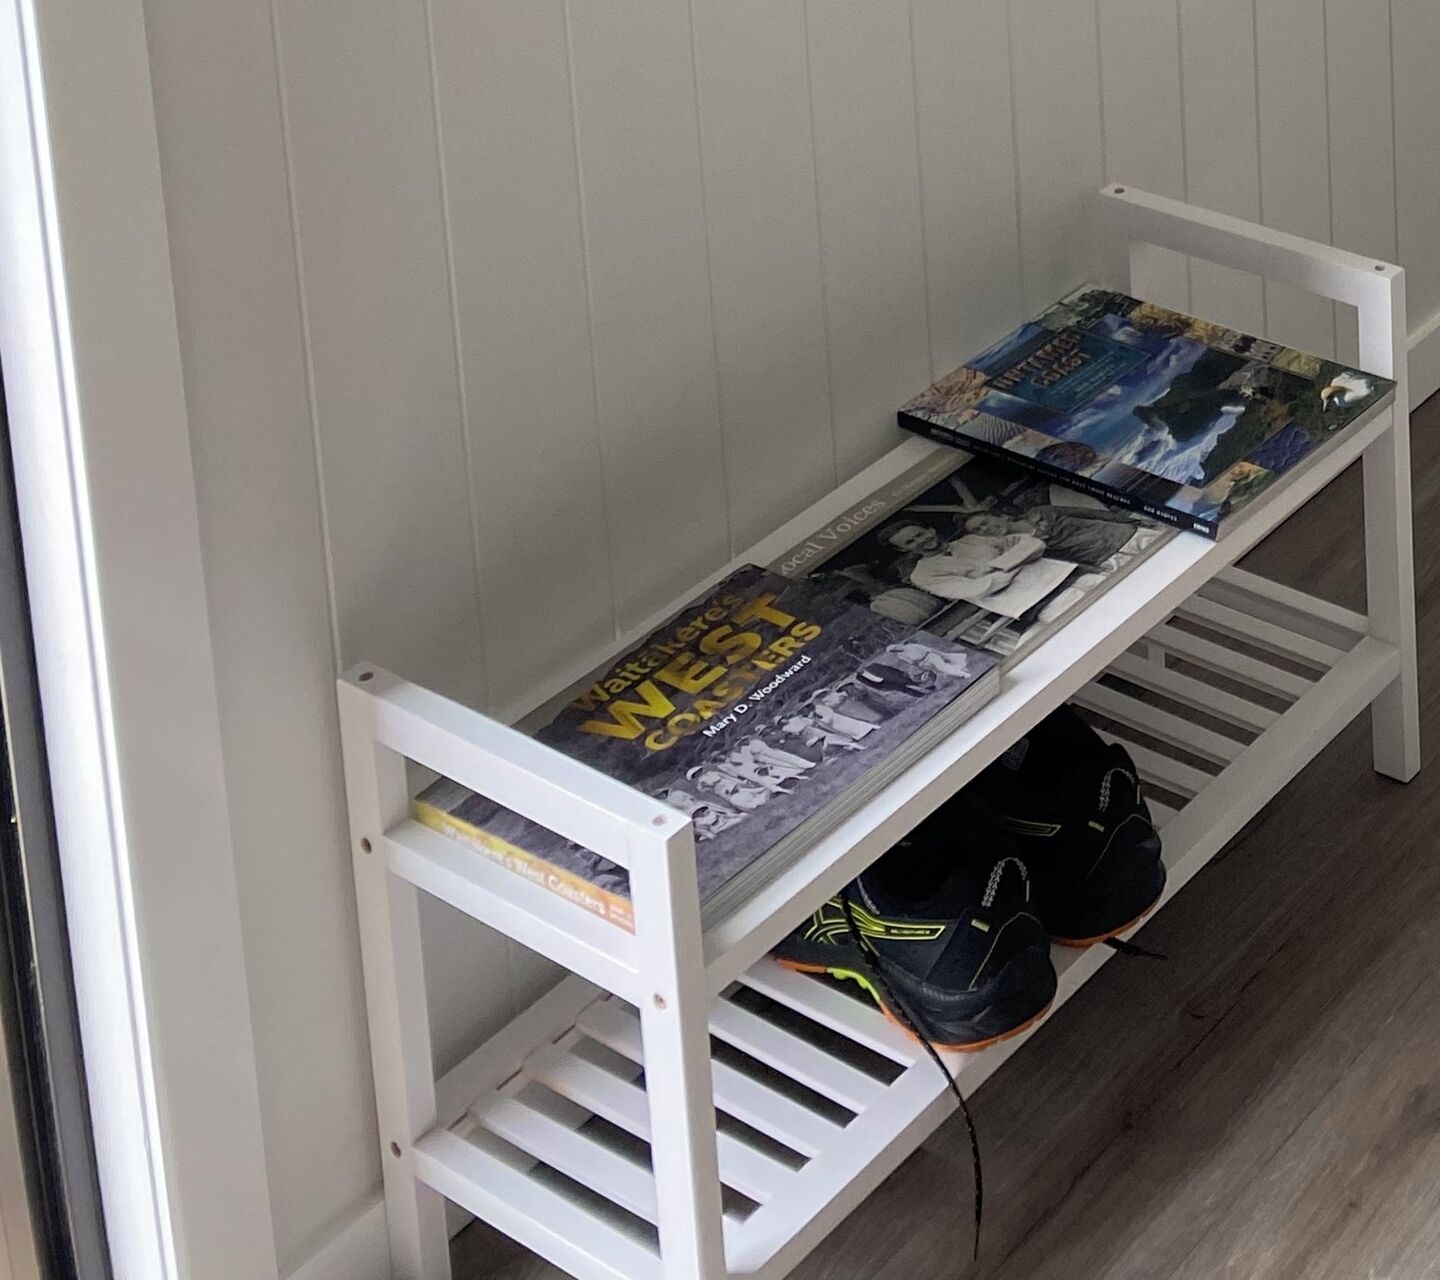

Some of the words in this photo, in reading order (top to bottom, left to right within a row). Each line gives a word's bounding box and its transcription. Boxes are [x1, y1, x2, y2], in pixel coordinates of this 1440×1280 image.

[780, 540, 825, 577] ocal
[817, 497, 886, 542] Voices
[576, 591, 797, 741] WEST
[644, 620, 823, 752] COASTERS
[702, 711, 738, 739] Mary
[733, 701, 752, 715] D.
[749, 653, 812, 704] Woodward
